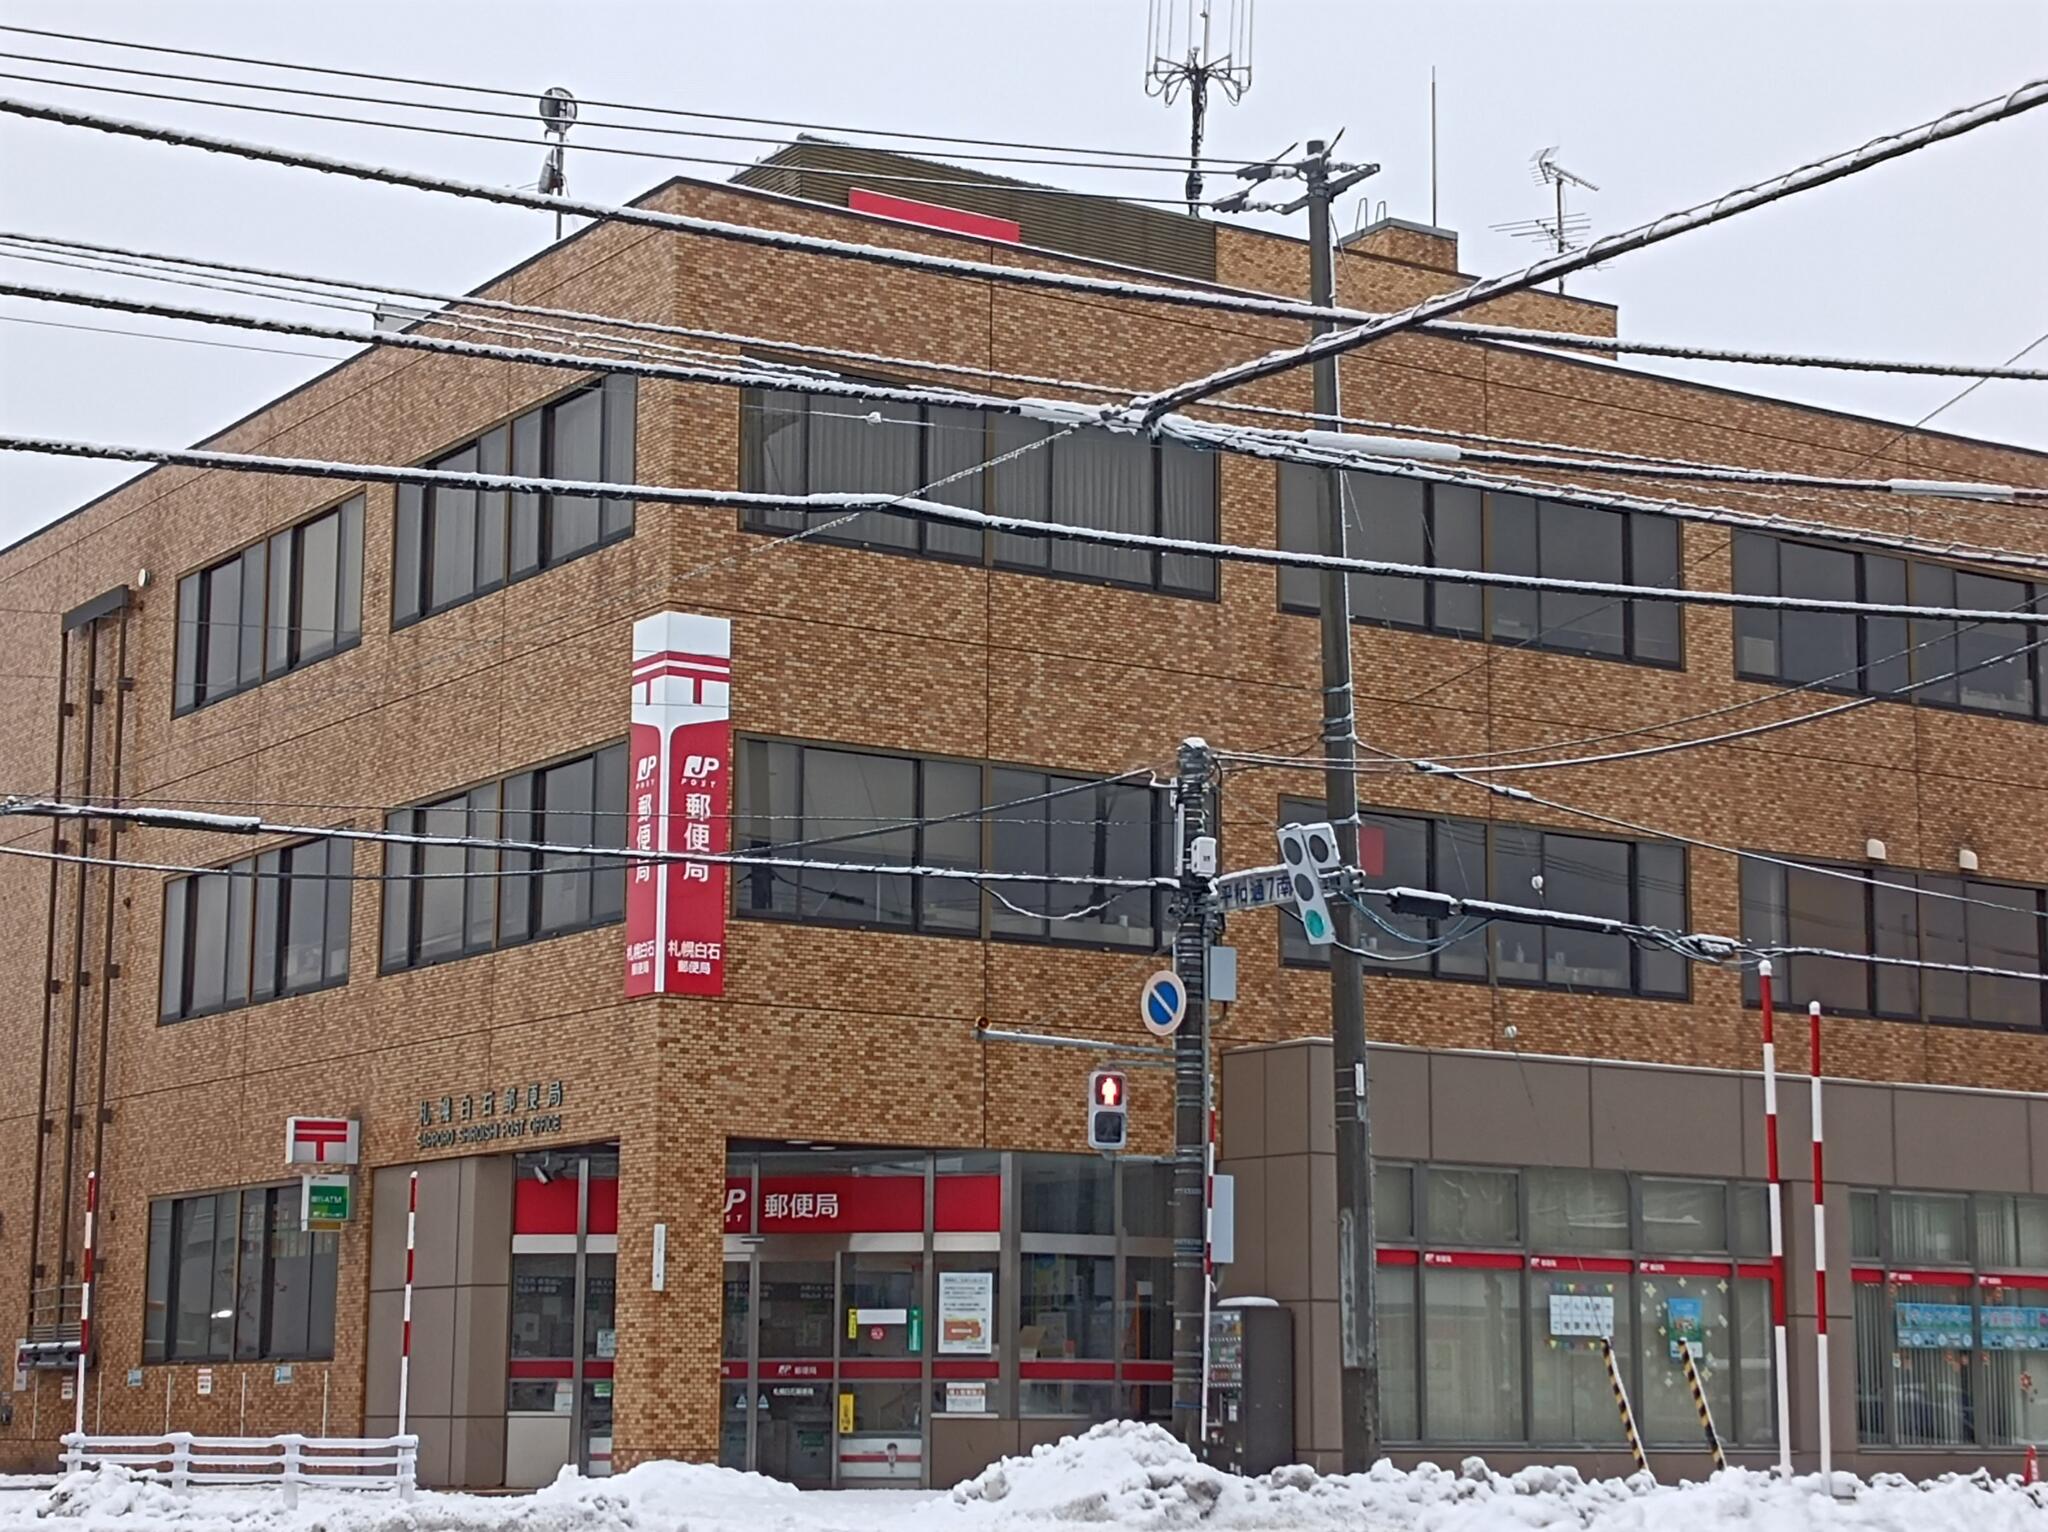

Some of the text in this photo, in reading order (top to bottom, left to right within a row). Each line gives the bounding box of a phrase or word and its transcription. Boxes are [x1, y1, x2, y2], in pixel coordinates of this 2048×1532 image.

[637, 755, 657, 781] JP
[683, 755, 720, 779] JP
[680, 778, 716, 788] POST
[667, 939, 721, 961] 札幌白石
[677, 960, 711, 975] 郵便局
[419, 1080, 563, 1126] 札幌白石郵便局
[416, 1114, 562, 1150] SAPPORO SHIROISHI POST OFFICE
[764, 1193, 839, 1219] 郵便局
